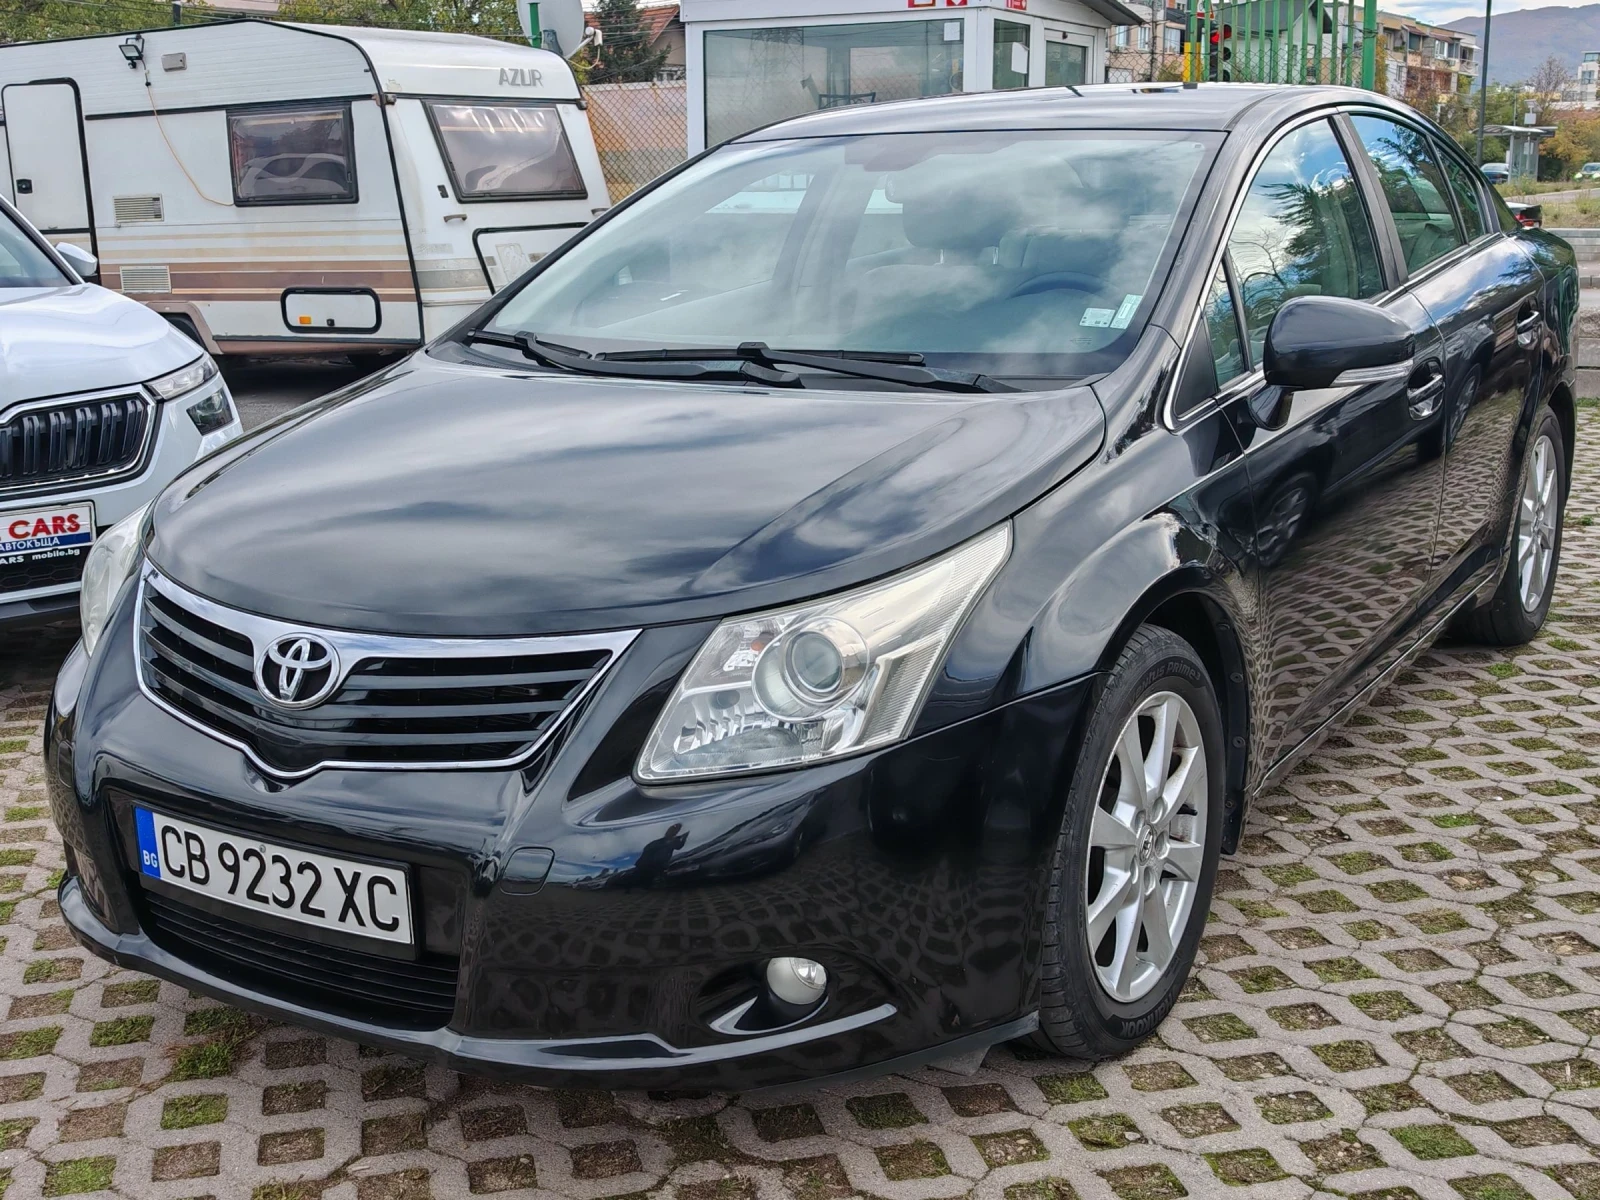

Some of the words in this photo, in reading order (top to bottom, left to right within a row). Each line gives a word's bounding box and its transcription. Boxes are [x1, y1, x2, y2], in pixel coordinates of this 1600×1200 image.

[499, 68, 543, 87] AZUR
[8, 513, 81, 539] CARS
[32, 548, 80, 560] mobile.bg
[143, 849, 157, 868] BG
[161, 825, 210, 885] CB
[217, 841, 326, 918] 9232
[333, 866, 400, 932] XC
